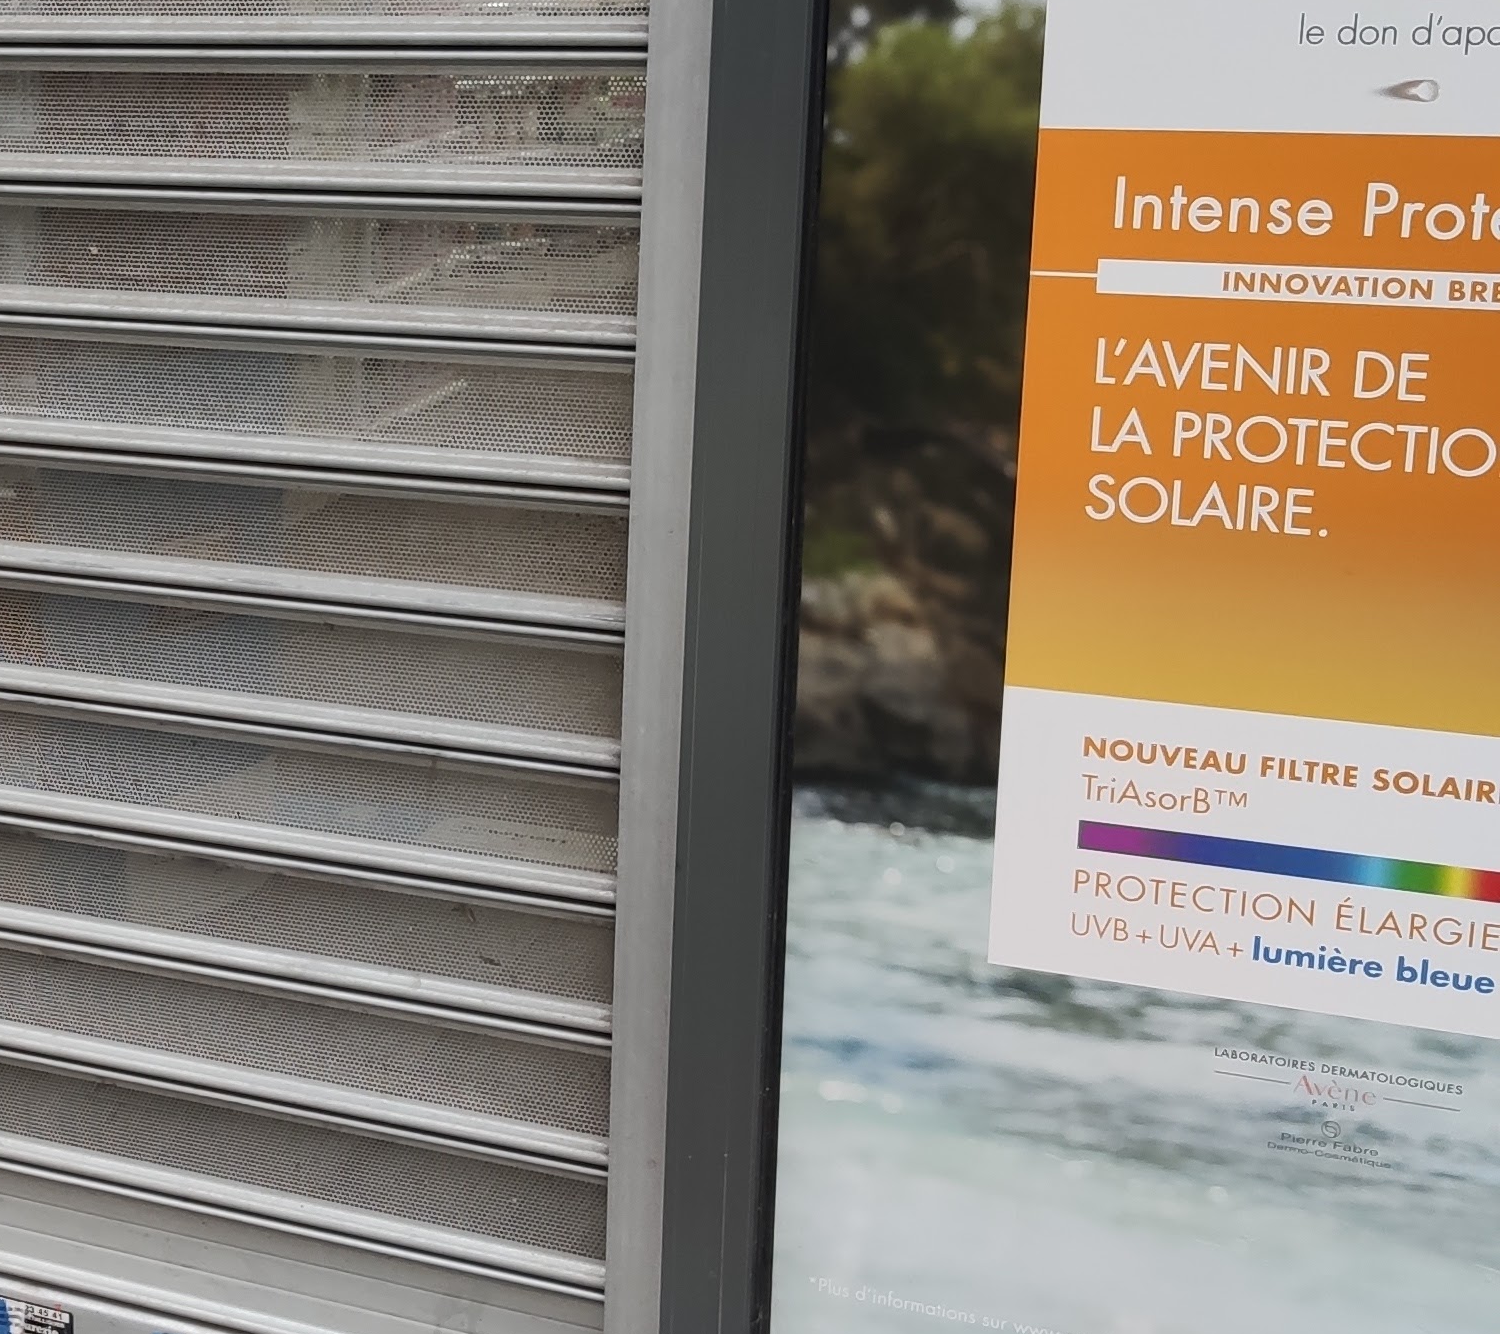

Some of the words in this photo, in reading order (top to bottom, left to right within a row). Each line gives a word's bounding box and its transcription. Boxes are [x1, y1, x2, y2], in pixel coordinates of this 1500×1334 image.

[1299, 13, 1325, 45] le
[1337, 13, 1398, 46] don
[1113, 175, 1334, 236] Intense
[1363, 182, 1500, 241] Prot
[1222, 271, 1434, 301] INNOVATION
[1095, 337, 1331, 397] L'AVENIR
[1353, 350, 1430, 402] DE
[1091, 406, 1152, 455] LA
[1173, 411, 1500, 478] PROTECTIO
[1085, 473, 1328, 538] SOLAIRE.
[1082, 736, 1247, 775] NOUVEAU
[1259, 756, 1359, 788] FILTRE
[1372, 768, 1500, 805] SOLAIR
[1073, 869, 1316, 927] PROTECTION
[1335, 896, 1500, 952] ÉLARGIE
[1252, 935, 1383, 979] lumière
[1396, 956, 1496, 994] bleue
[1214, 1047, 1316, 1072] LABORATOIRES
[1320, 1063, 1464, 1096] DERMATOLOGIQUES
[1292, 1075, 1378, 1106] Avène
[1311, 1099, 1356, 1112] PARIS
[1266, 1141, 1392, 1170] Dermo-Cosmétique
[1280, 1132, 1328, 1148] Pierre
[1332, 1141, 1379, 1158] Fabre
[856, 1287, 977, 1326] d'informations
[981, 1315, 1008, 1332] sur
